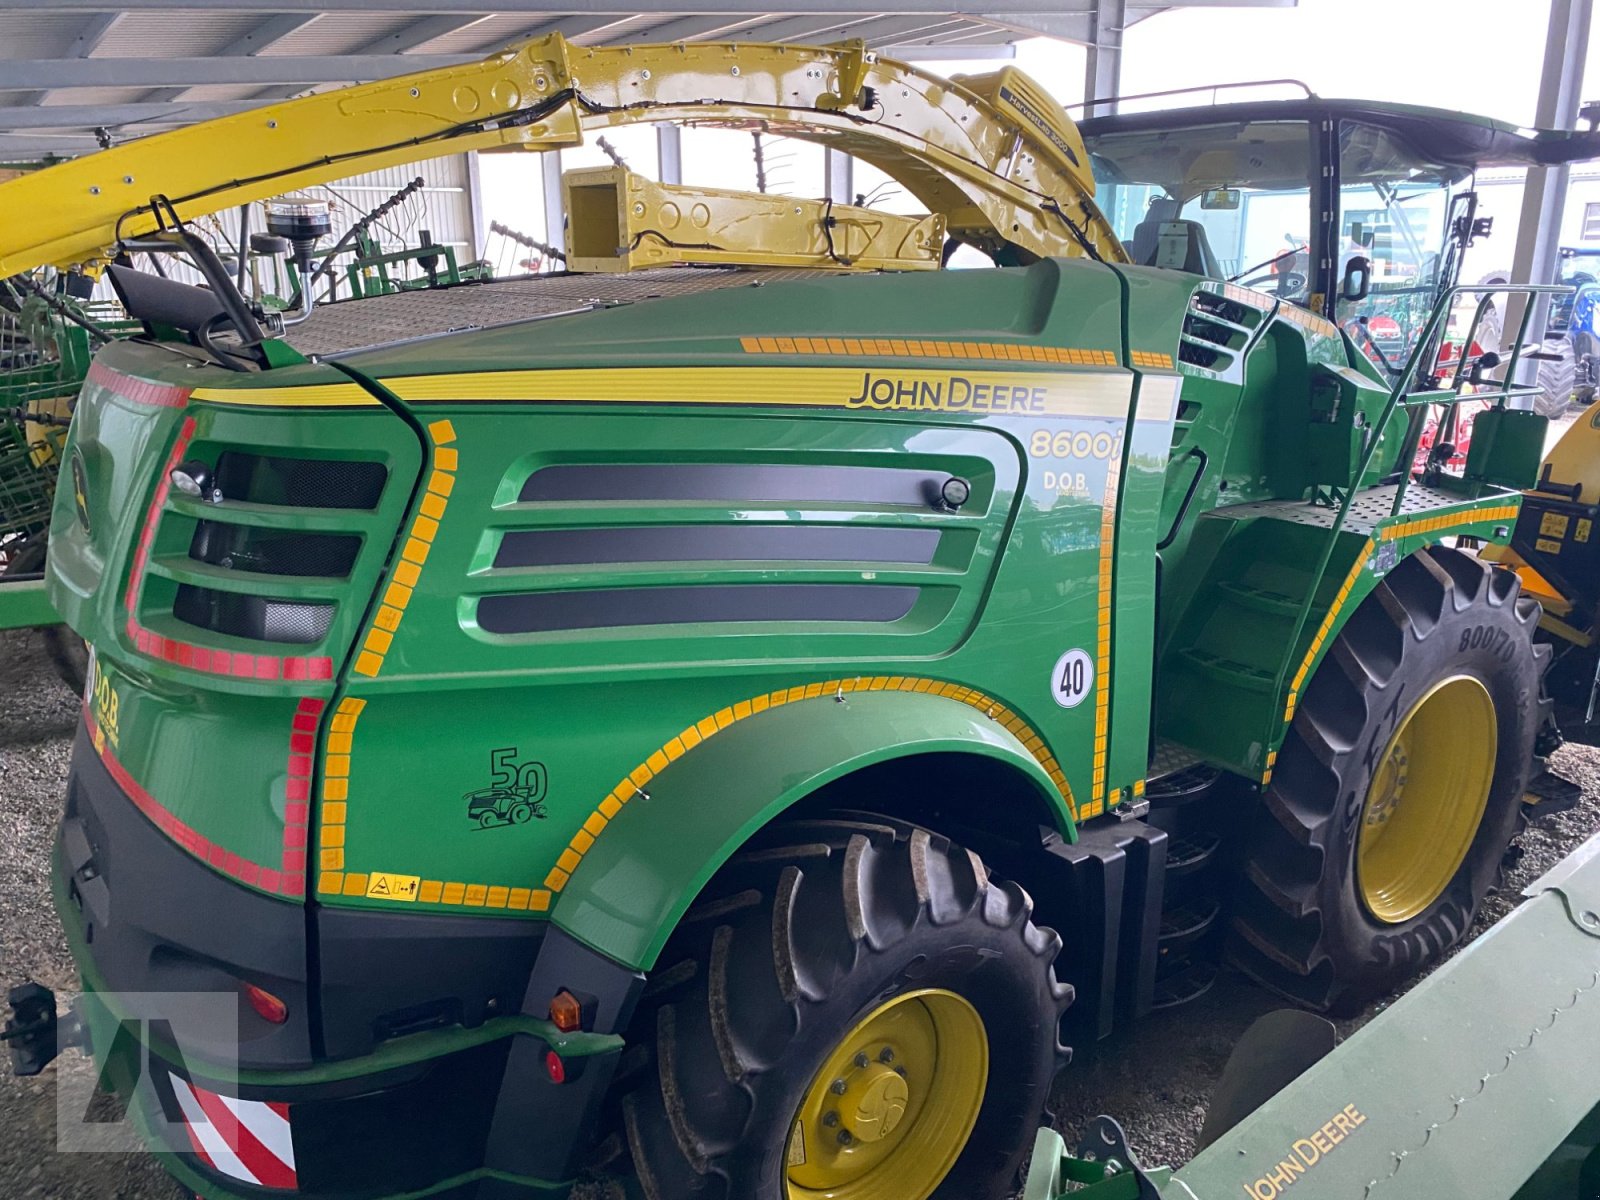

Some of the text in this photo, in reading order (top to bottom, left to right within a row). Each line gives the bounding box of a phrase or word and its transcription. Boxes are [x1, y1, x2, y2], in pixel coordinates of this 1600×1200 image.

[1009, 95, 1068, 152] HarvestLab 3000
[849, 372, 1048, 412] JOHN DEERE
[1029, 428, 1124, 461] 8600i
[1043, 471, 1089, 490] D.O.B.
[1458, 625, 1516, 663] 800/70
[1060, 658, 1083, 697] 40
[491, 747, 547, 804] 50
[1291, 1102, 1367, 1166] DEERE
